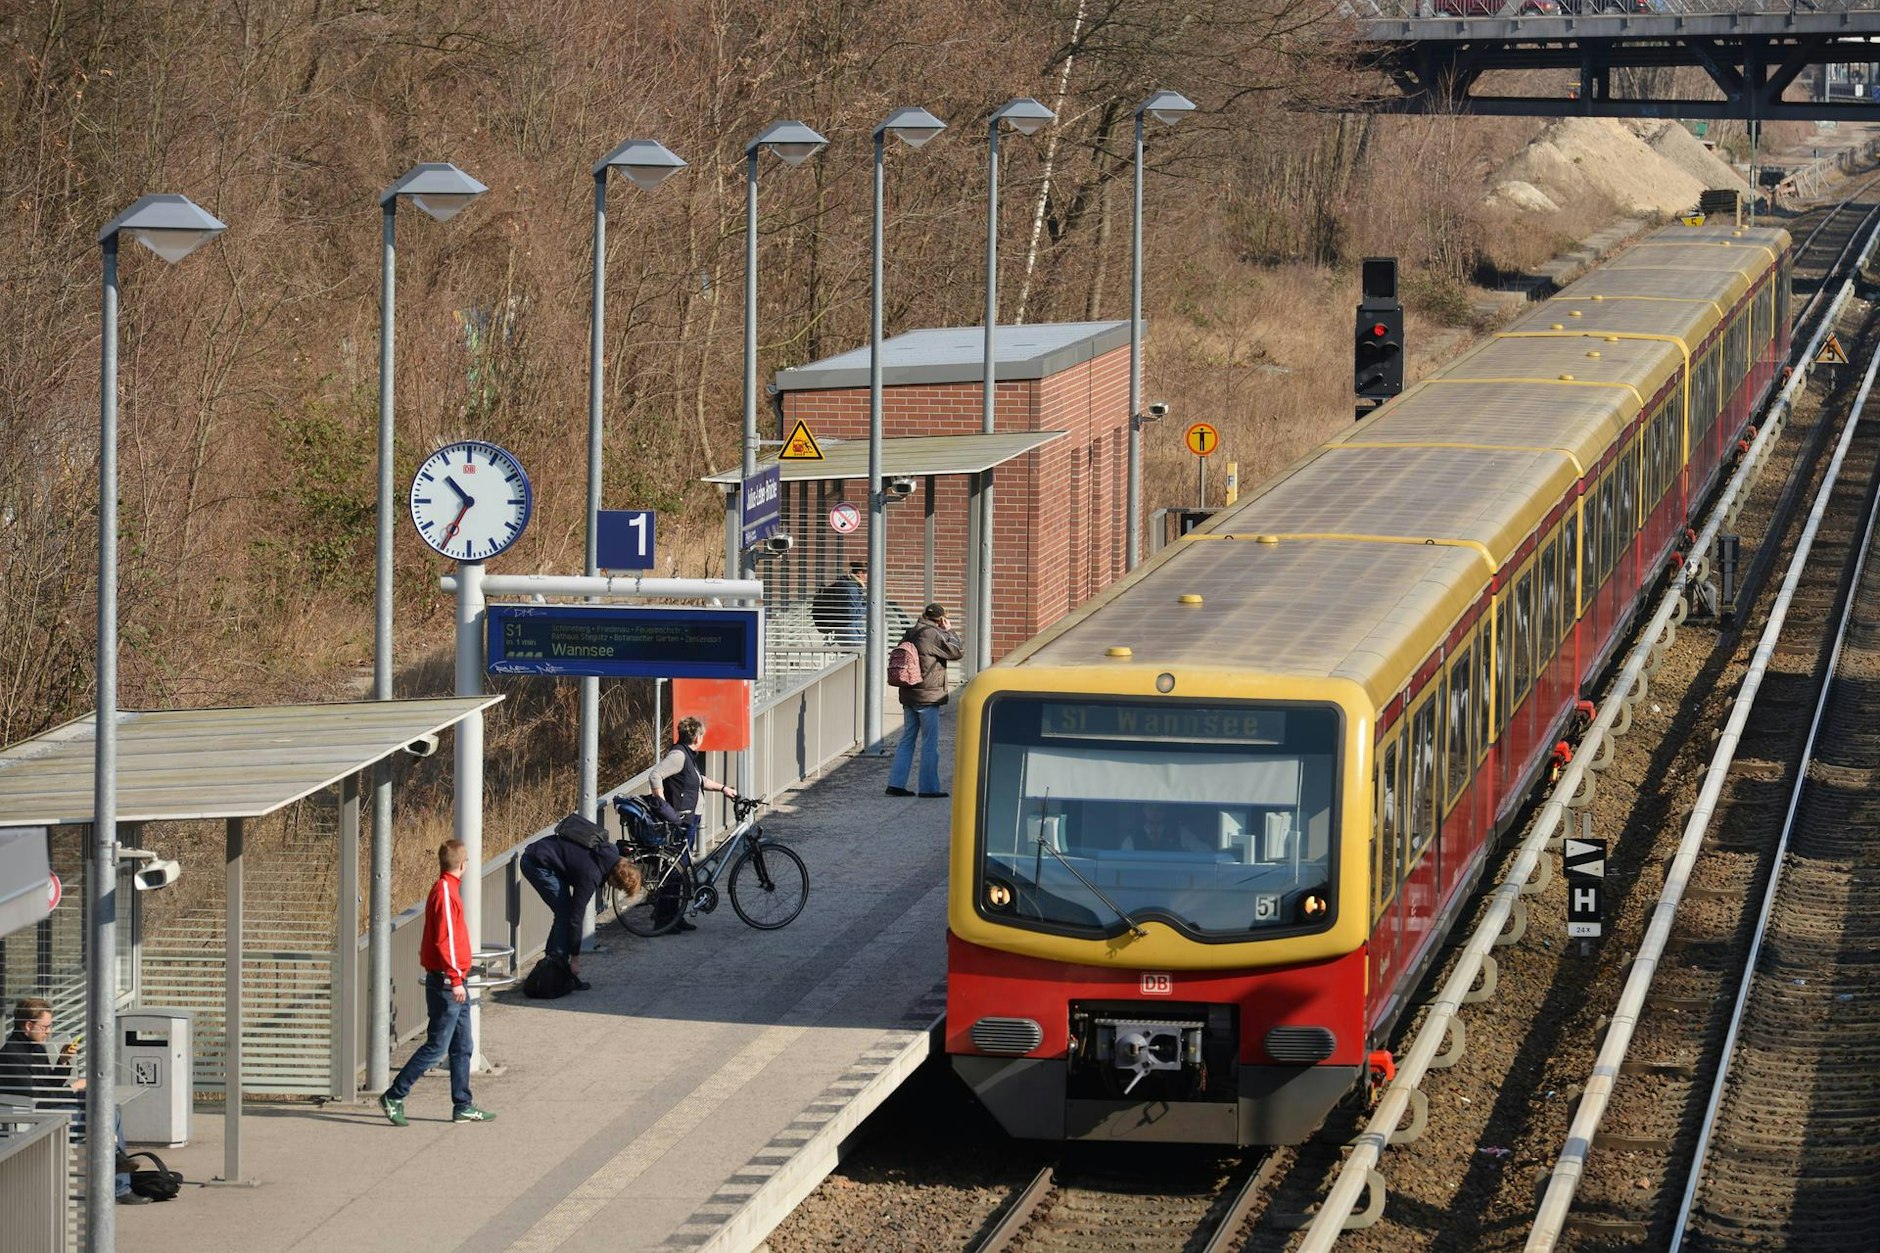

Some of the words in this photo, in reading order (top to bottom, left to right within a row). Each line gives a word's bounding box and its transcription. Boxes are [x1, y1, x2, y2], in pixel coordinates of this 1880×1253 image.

[1827, 344, 1835, 361] 5
[463, 465, 476, 474] DB
[629, 512, 646, 546] 1
[505, 623, 522, 637] S1
[551, 643, 614, 657] Wannsee
[1062, 705, 1087, 729] S1
[1117, 707, 1259, 736] Wannsee
[1257, 894, 1278, 917] 51
[1574, 888, 1595, 912] H
[1143, 975, 1169, 991] DB
